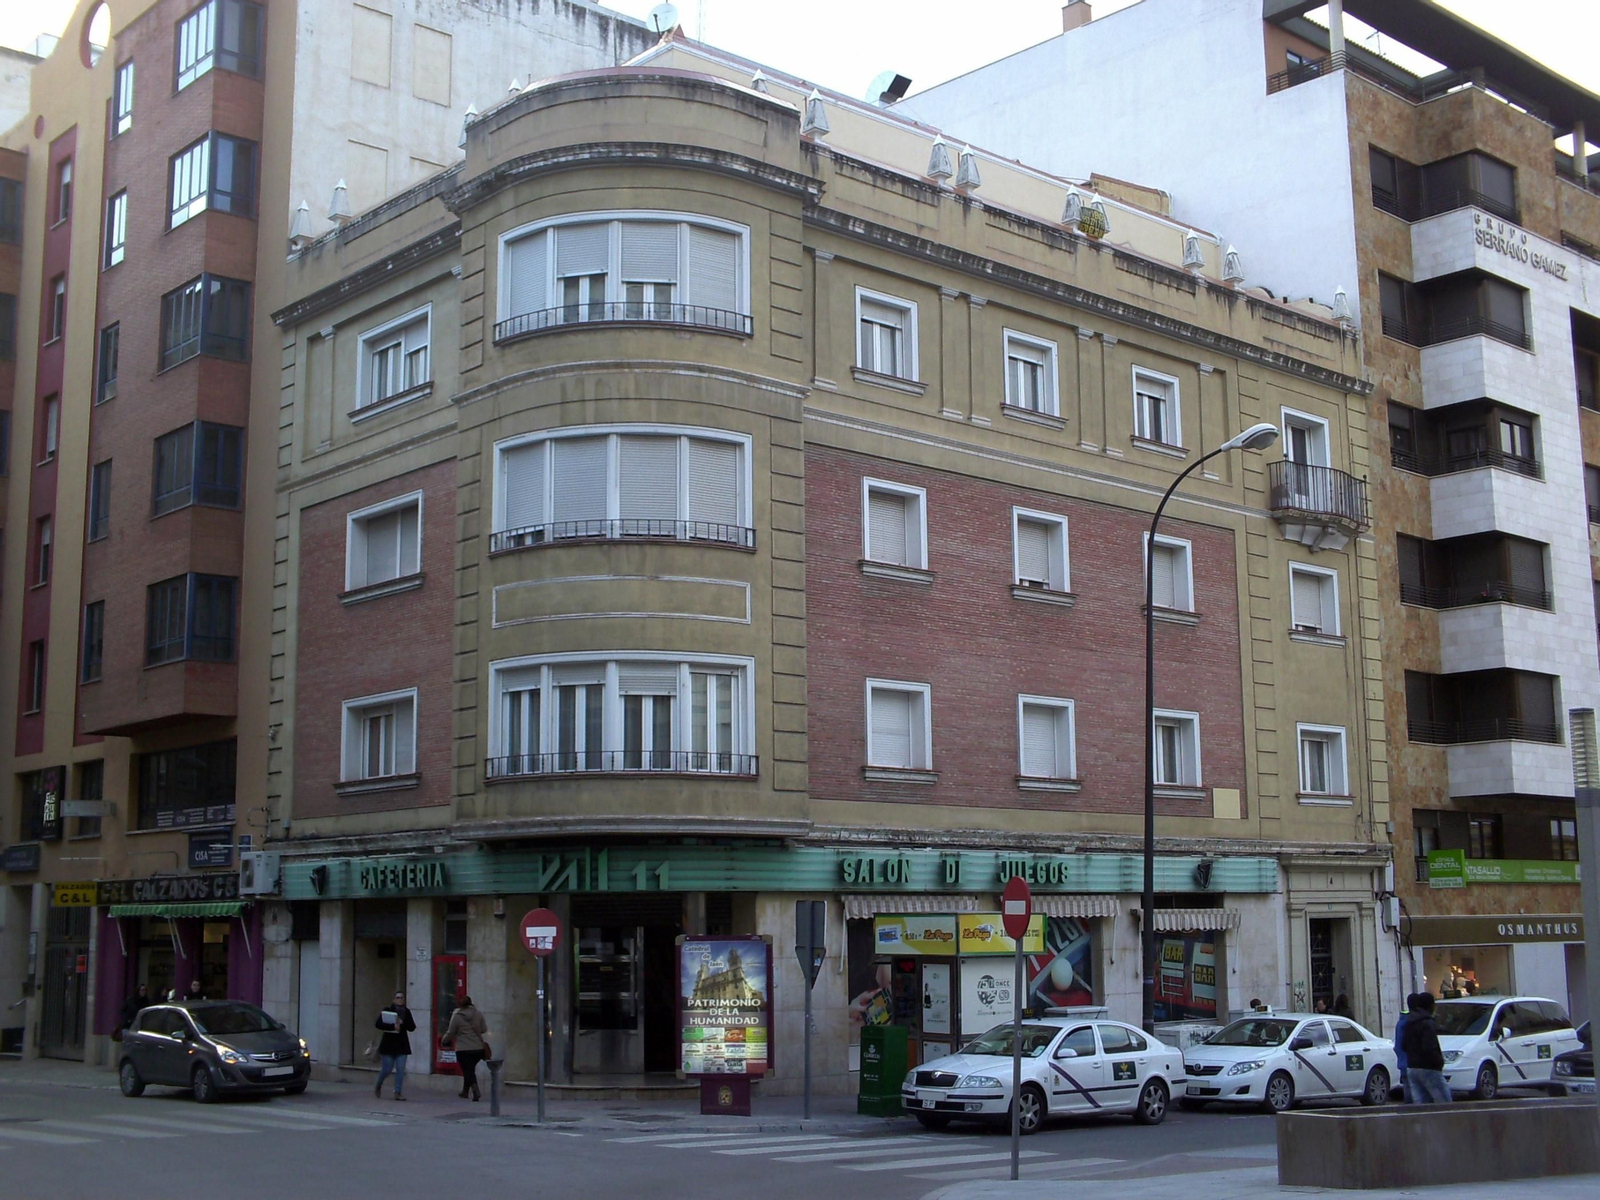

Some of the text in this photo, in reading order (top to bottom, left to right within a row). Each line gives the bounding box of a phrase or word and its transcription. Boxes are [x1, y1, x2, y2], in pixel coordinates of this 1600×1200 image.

[1473, 213, 1527, 244] GRUPO
[1475, 228, 1528, 263] SERRANO
[194, 851, 209, 861] CISA
[361, 862, 444, 889] CAFETERIA
[841, 858, 912, 883] SALON
[1000, 860, 1070, 883] JUEGOS
[133, 878, 210, 900] CALZADOS
[1497, 922, 1578, 935] OSMANTHUS
[1165, 945, 1183, 961] BAR
[687, 998, 761, 1007] PATRIMONIO
[689, 1017, 759, 1025] HUMANIDAD
